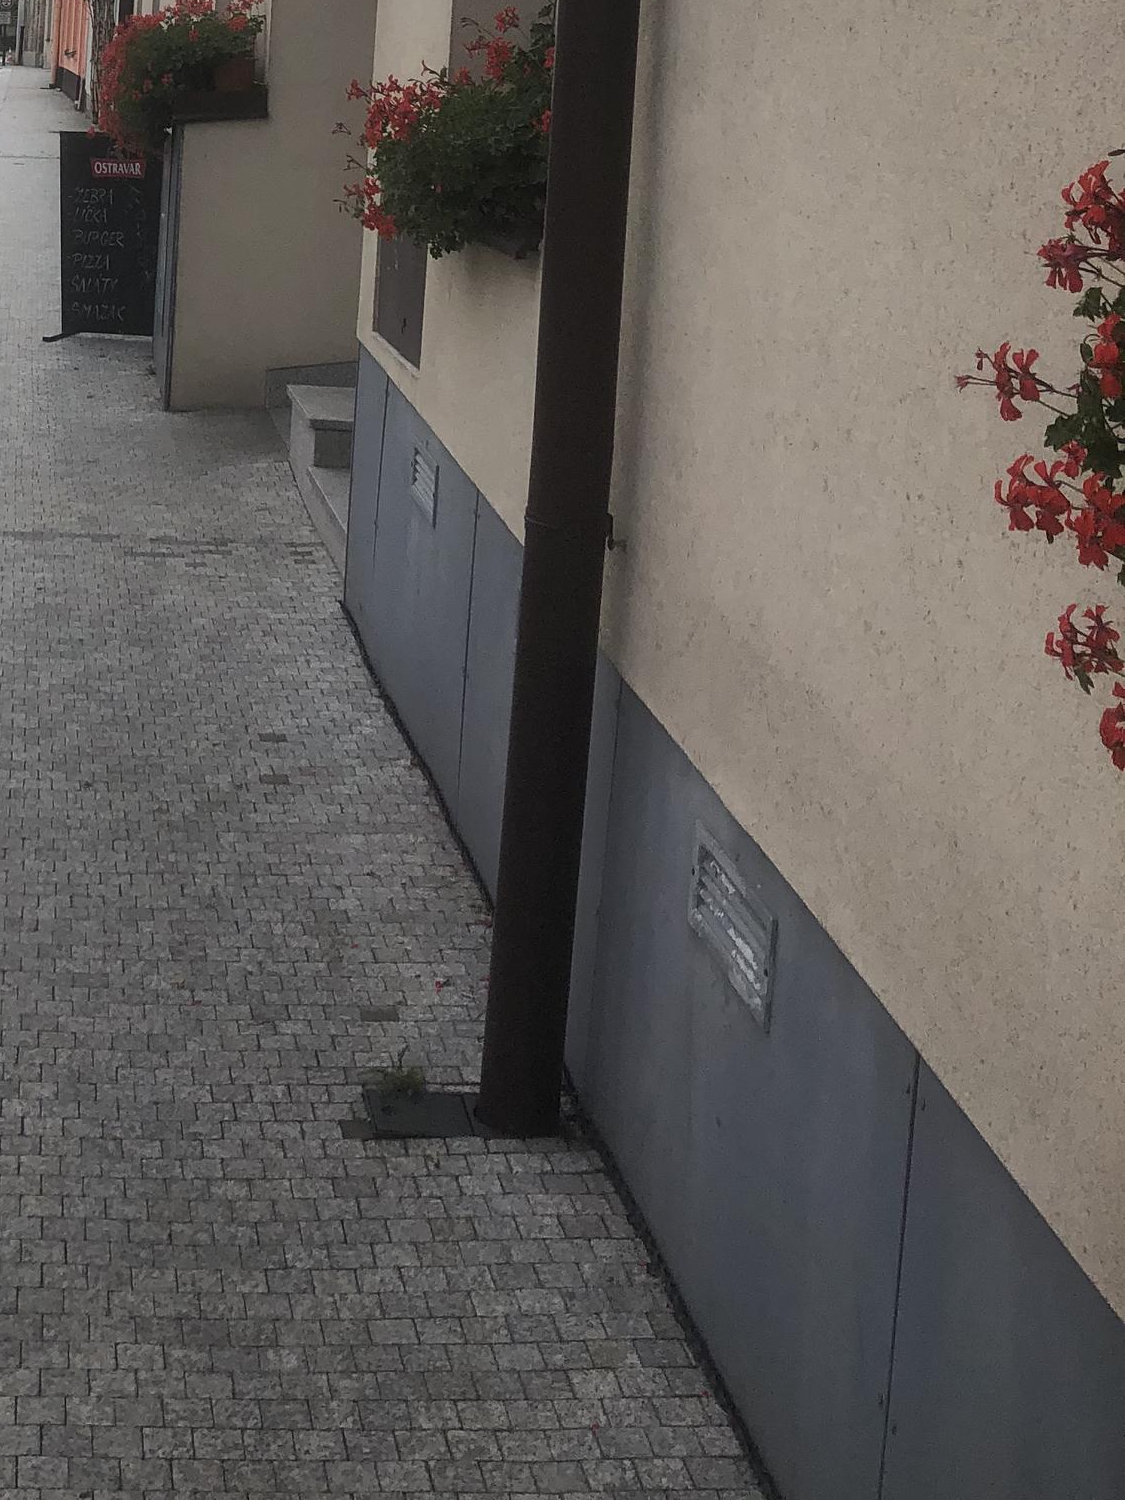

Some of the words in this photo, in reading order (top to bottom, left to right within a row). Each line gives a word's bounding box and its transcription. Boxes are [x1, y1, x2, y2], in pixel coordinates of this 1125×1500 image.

[94, 161, 142, 175] OSTRAVAR
[73, 229, 124, 247] BURGER
[72, 253, 109, 270] PIZZA
